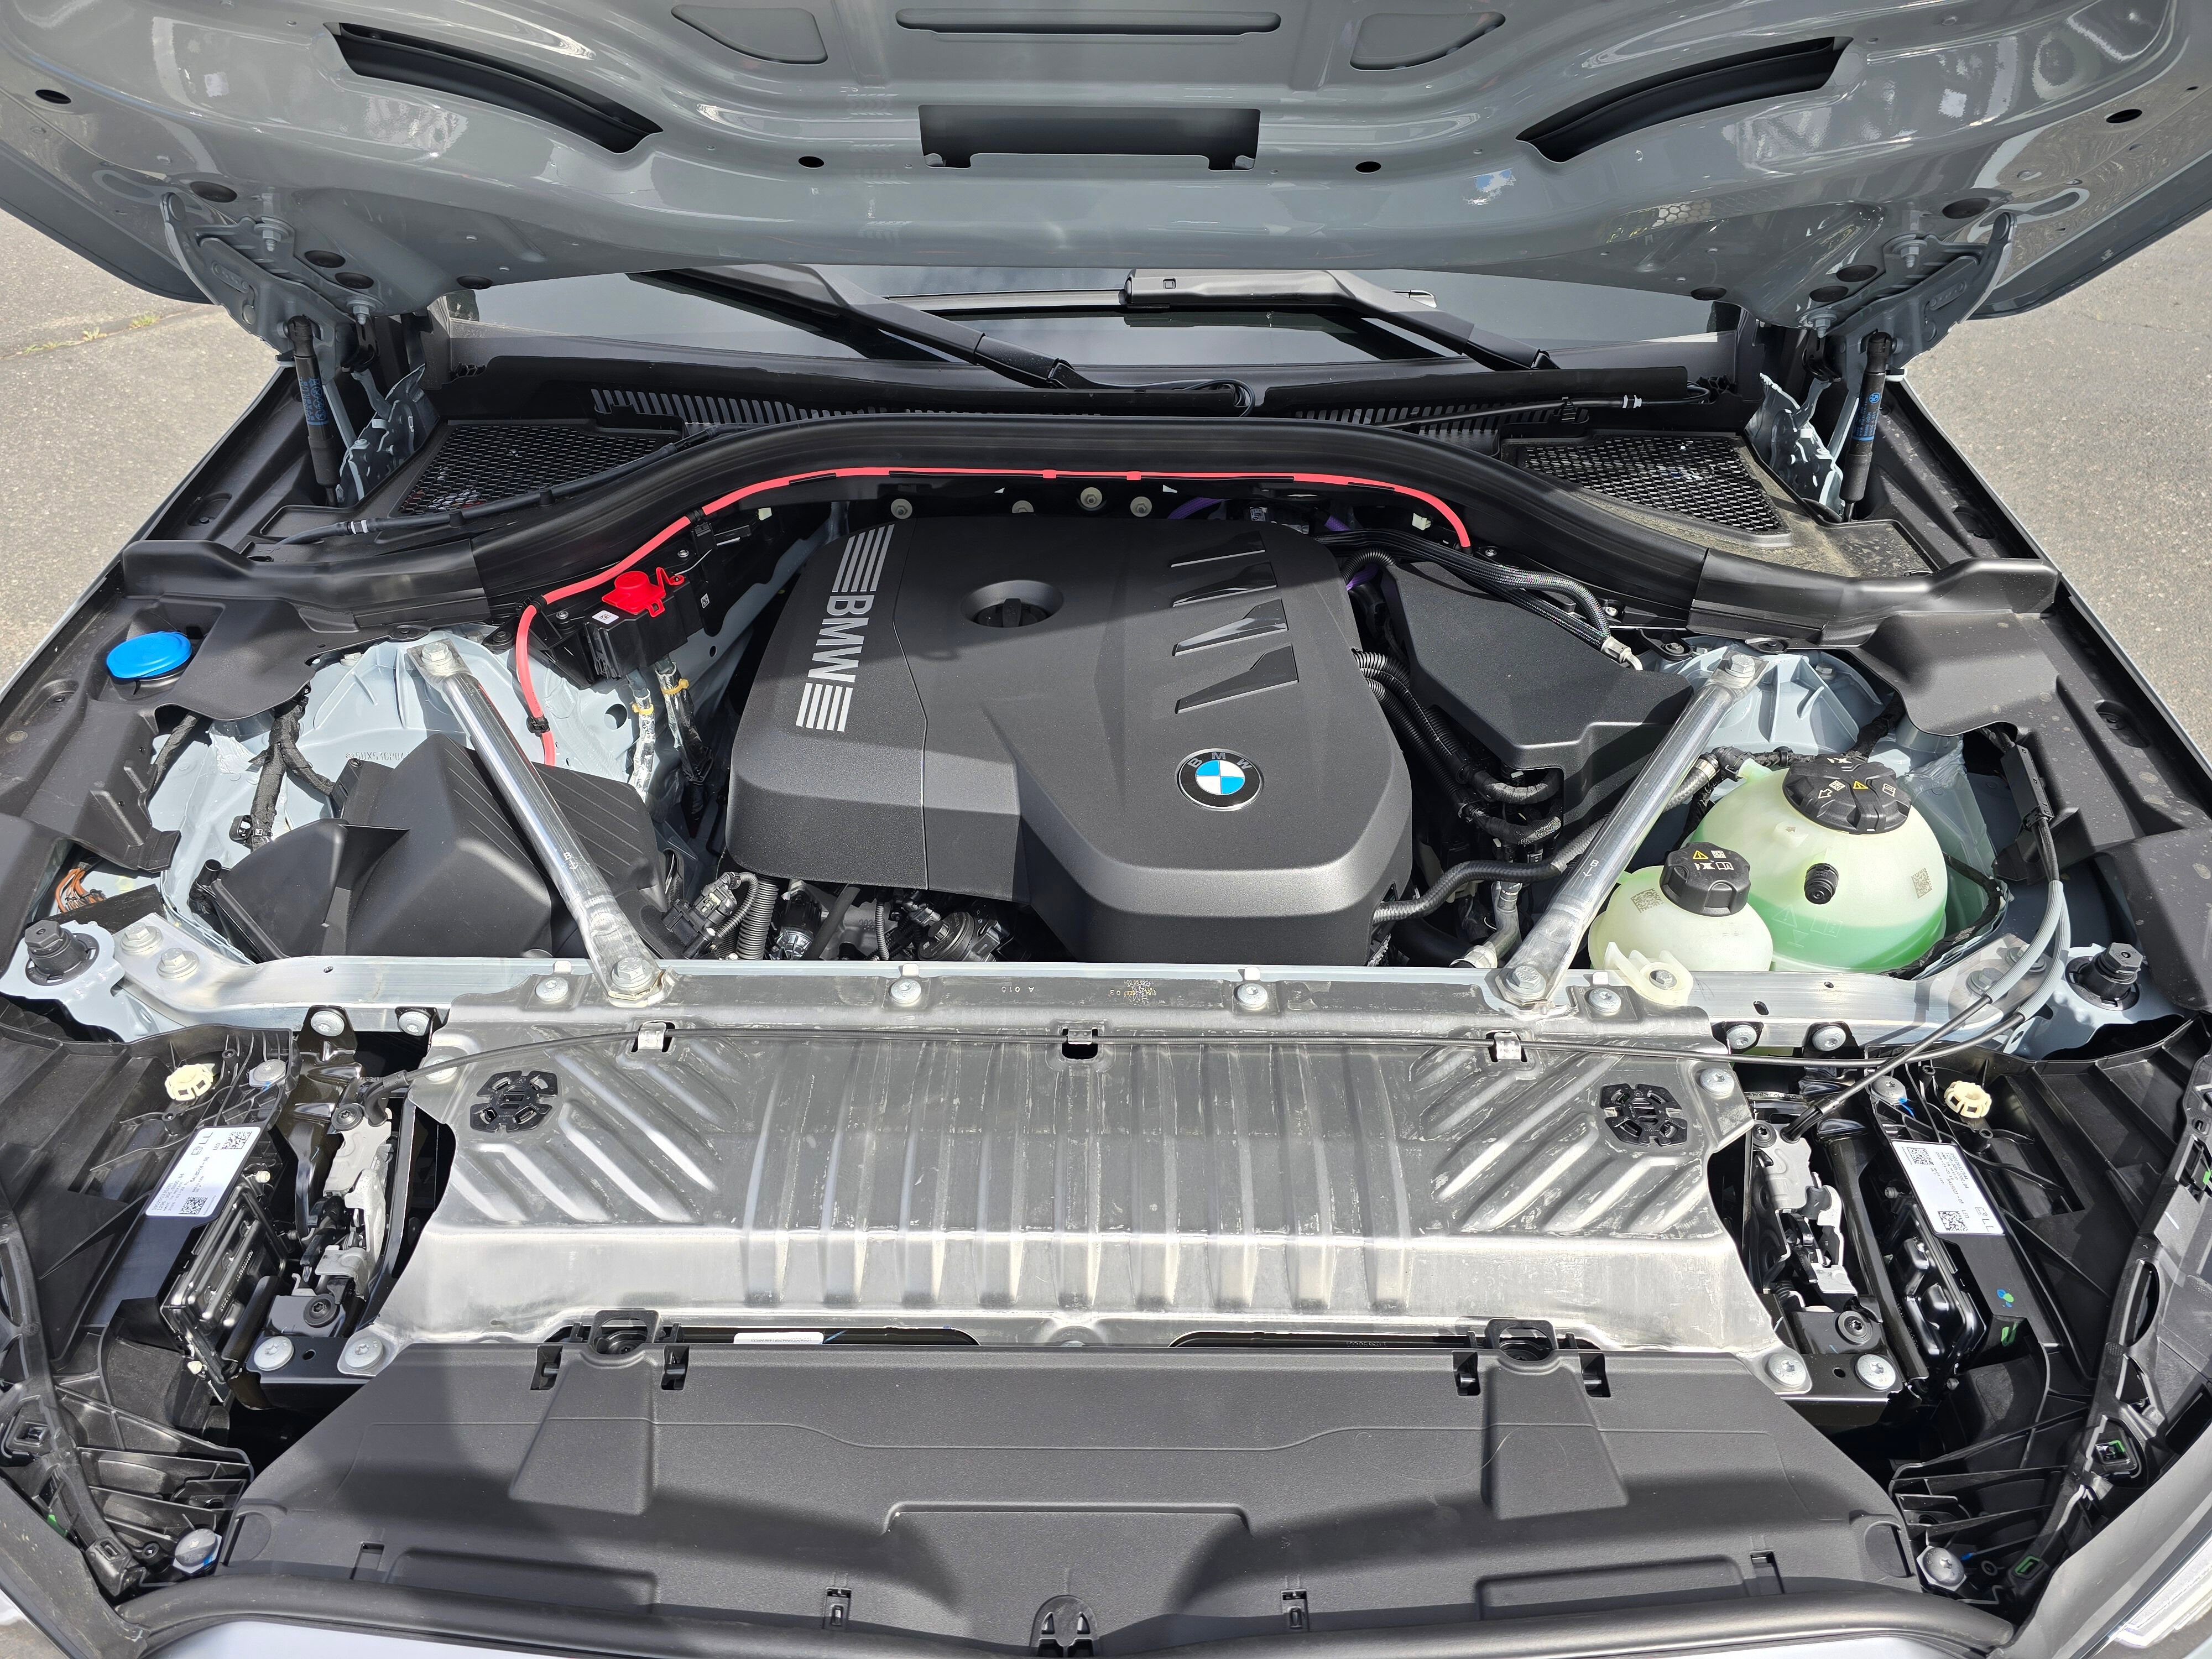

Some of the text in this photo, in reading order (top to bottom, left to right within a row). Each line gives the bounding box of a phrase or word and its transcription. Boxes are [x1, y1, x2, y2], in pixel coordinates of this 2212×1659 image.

[808, 595, 875, 682] BMW
[1187, 752, 1253, 769] BMW
[564, 852, 572, 860] B
[198, 1131, 213, 1144] LL
[1961, 1209, 1970, 1218] LED
[1982, 1218, 1994, 1232] LL
